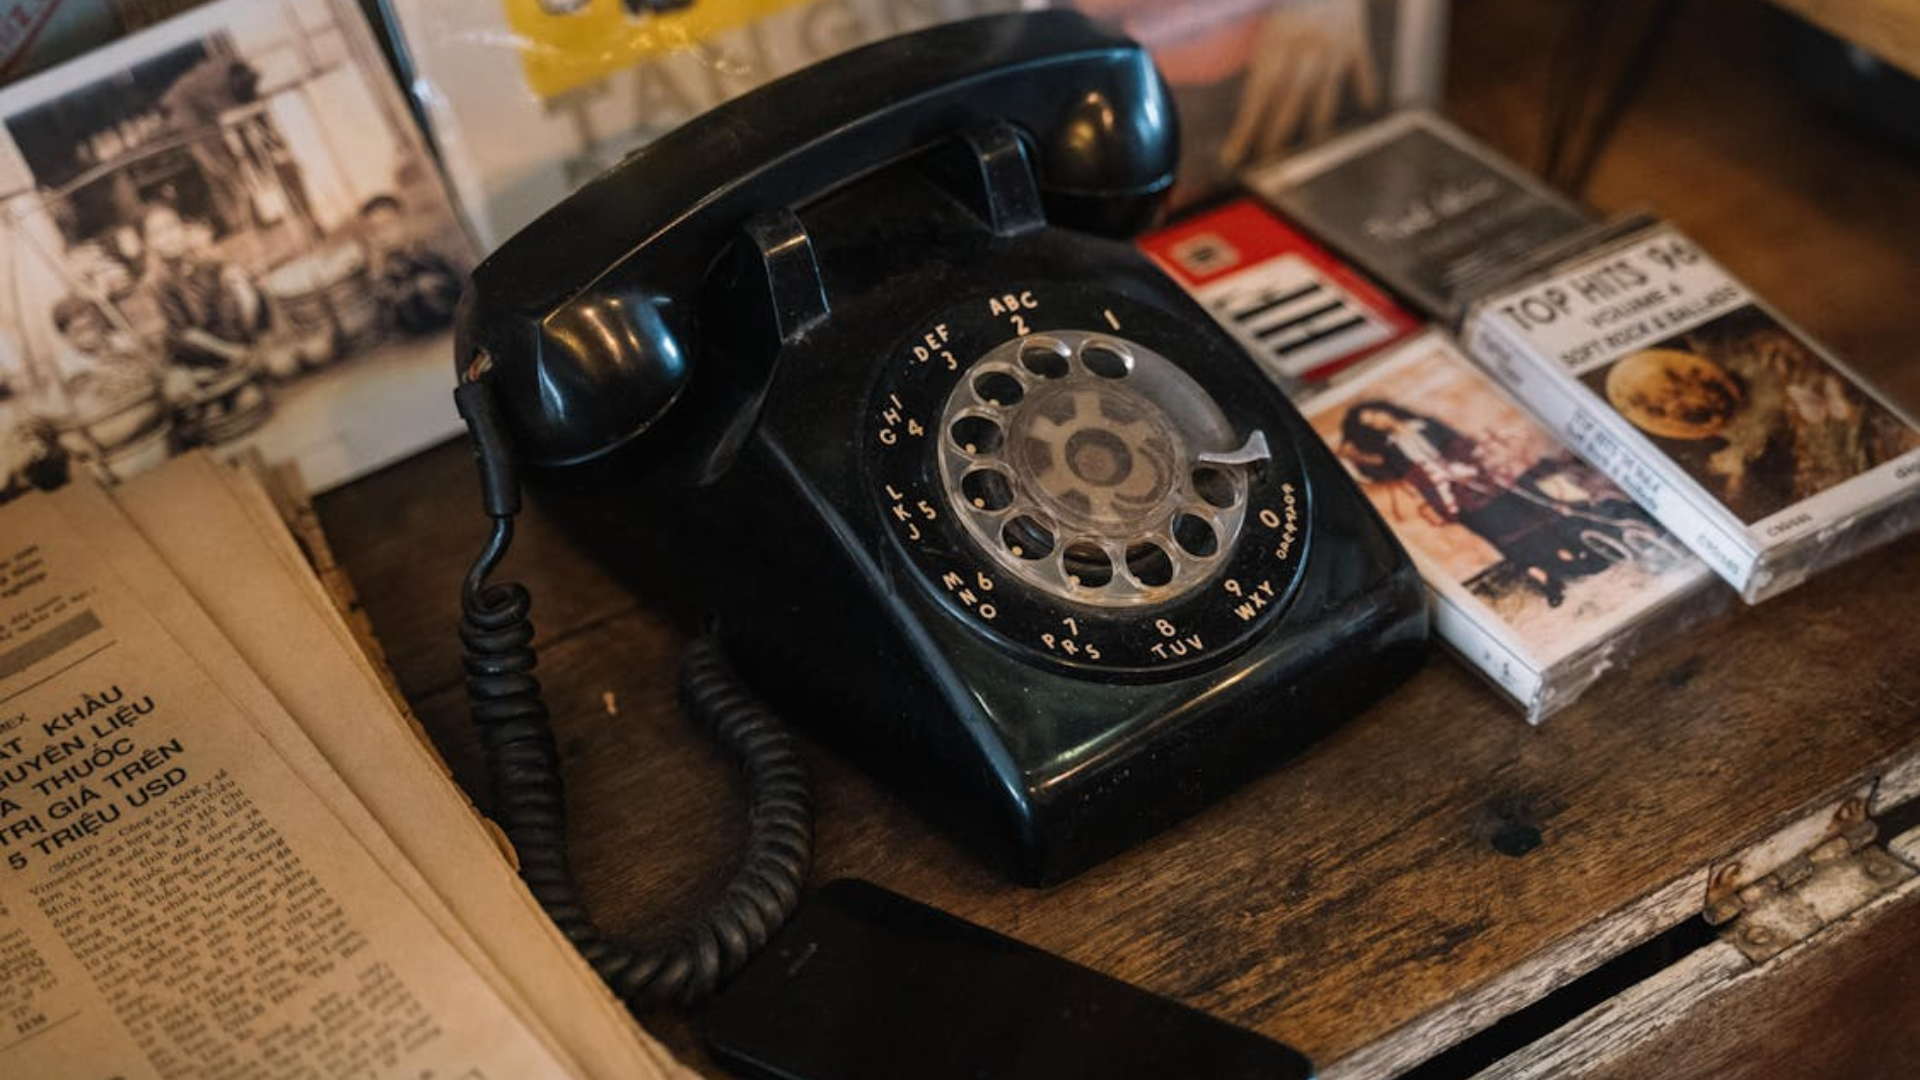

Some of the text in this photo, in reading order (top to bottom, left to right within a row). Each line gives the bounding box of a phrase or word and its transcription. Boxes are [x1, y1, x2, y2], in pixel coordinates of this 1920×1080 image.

[988, 291, 1039, 317] ABC
[1501, 286, 1571, 331] TOP
[1570, 259, 1648, 304] HITS
[1104, 308, 1121, 332] 1
[1587, 289, 1667, 329] VOLUME
[1011, 314, 1031, 337] 2
[912, 323, 952, 364] DEF
[940, 350, 958, 371] 3
[908, 419, 925, 438] 4
[917, 500, 937, 520] 5
[977, 571, 993, 591] 6
[1224, 578, 1243, 597] 9
[1233, 581, 1276, 623] WXY
[1063, 617, 1079, 636] 7
[1155, 618, 1176, 637] 8
[1040, 632, 1101, 660] PRS
[1150, 633, 1205, 663] TUV
[91, 695, 155, 738] LIỆU
[31, 737, 135, 796] THUỐC
[48, 785, 101, 819] GIÁ
[102, 738, 184, 788] TRÊN
[8, 767, 187, 870] 5 TRIỆU USD
